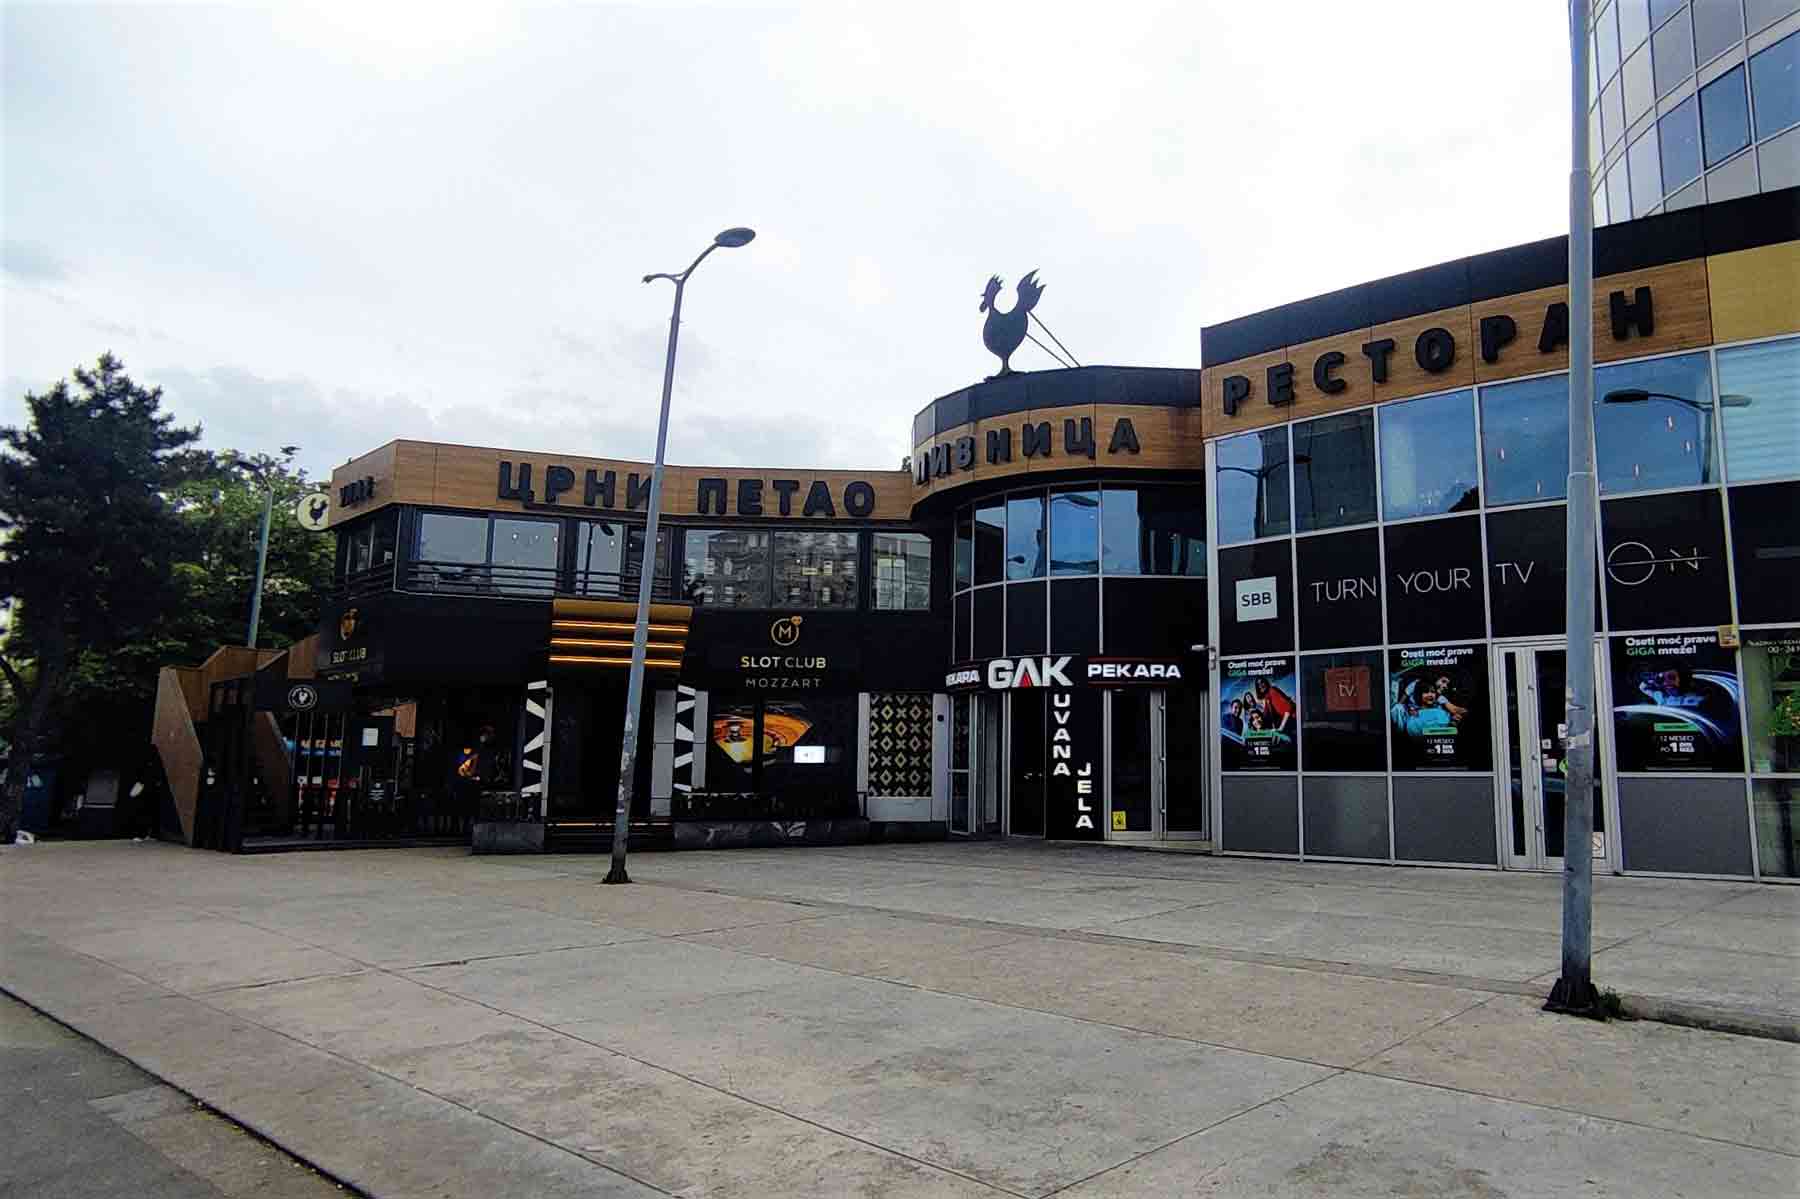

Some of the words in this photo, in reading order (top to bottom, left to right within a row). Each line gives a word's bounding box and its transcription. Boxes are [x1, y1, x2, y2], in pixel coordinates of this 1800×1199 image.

[1222, 286, 1655, 417] РЕСТОРАН
[914, 416, 1141, 485] ПИВНИЦА
[497, 461, 652, 509] ЦРНИ
[697, 478, 876, 516] ПЕТАО
[1311, 576, 1377, 603] TURN
[1397, 567, 1472, 594] YOUR
[1496, 561, 1535, 584] TV
[1241, 591, 1272, 607] SBB
[741, 656, 781, 668] SLOT
[784, 657, 826, 669] CLUB
[1626, 647, 1656, 656] GIGA
[745, 678, 822, 688] MOZZART
[987, 656, 1075, 689] GAK
[1086, 663, 1182, 678] PEKARA
[1075, 762, 1094, 829] JELA
